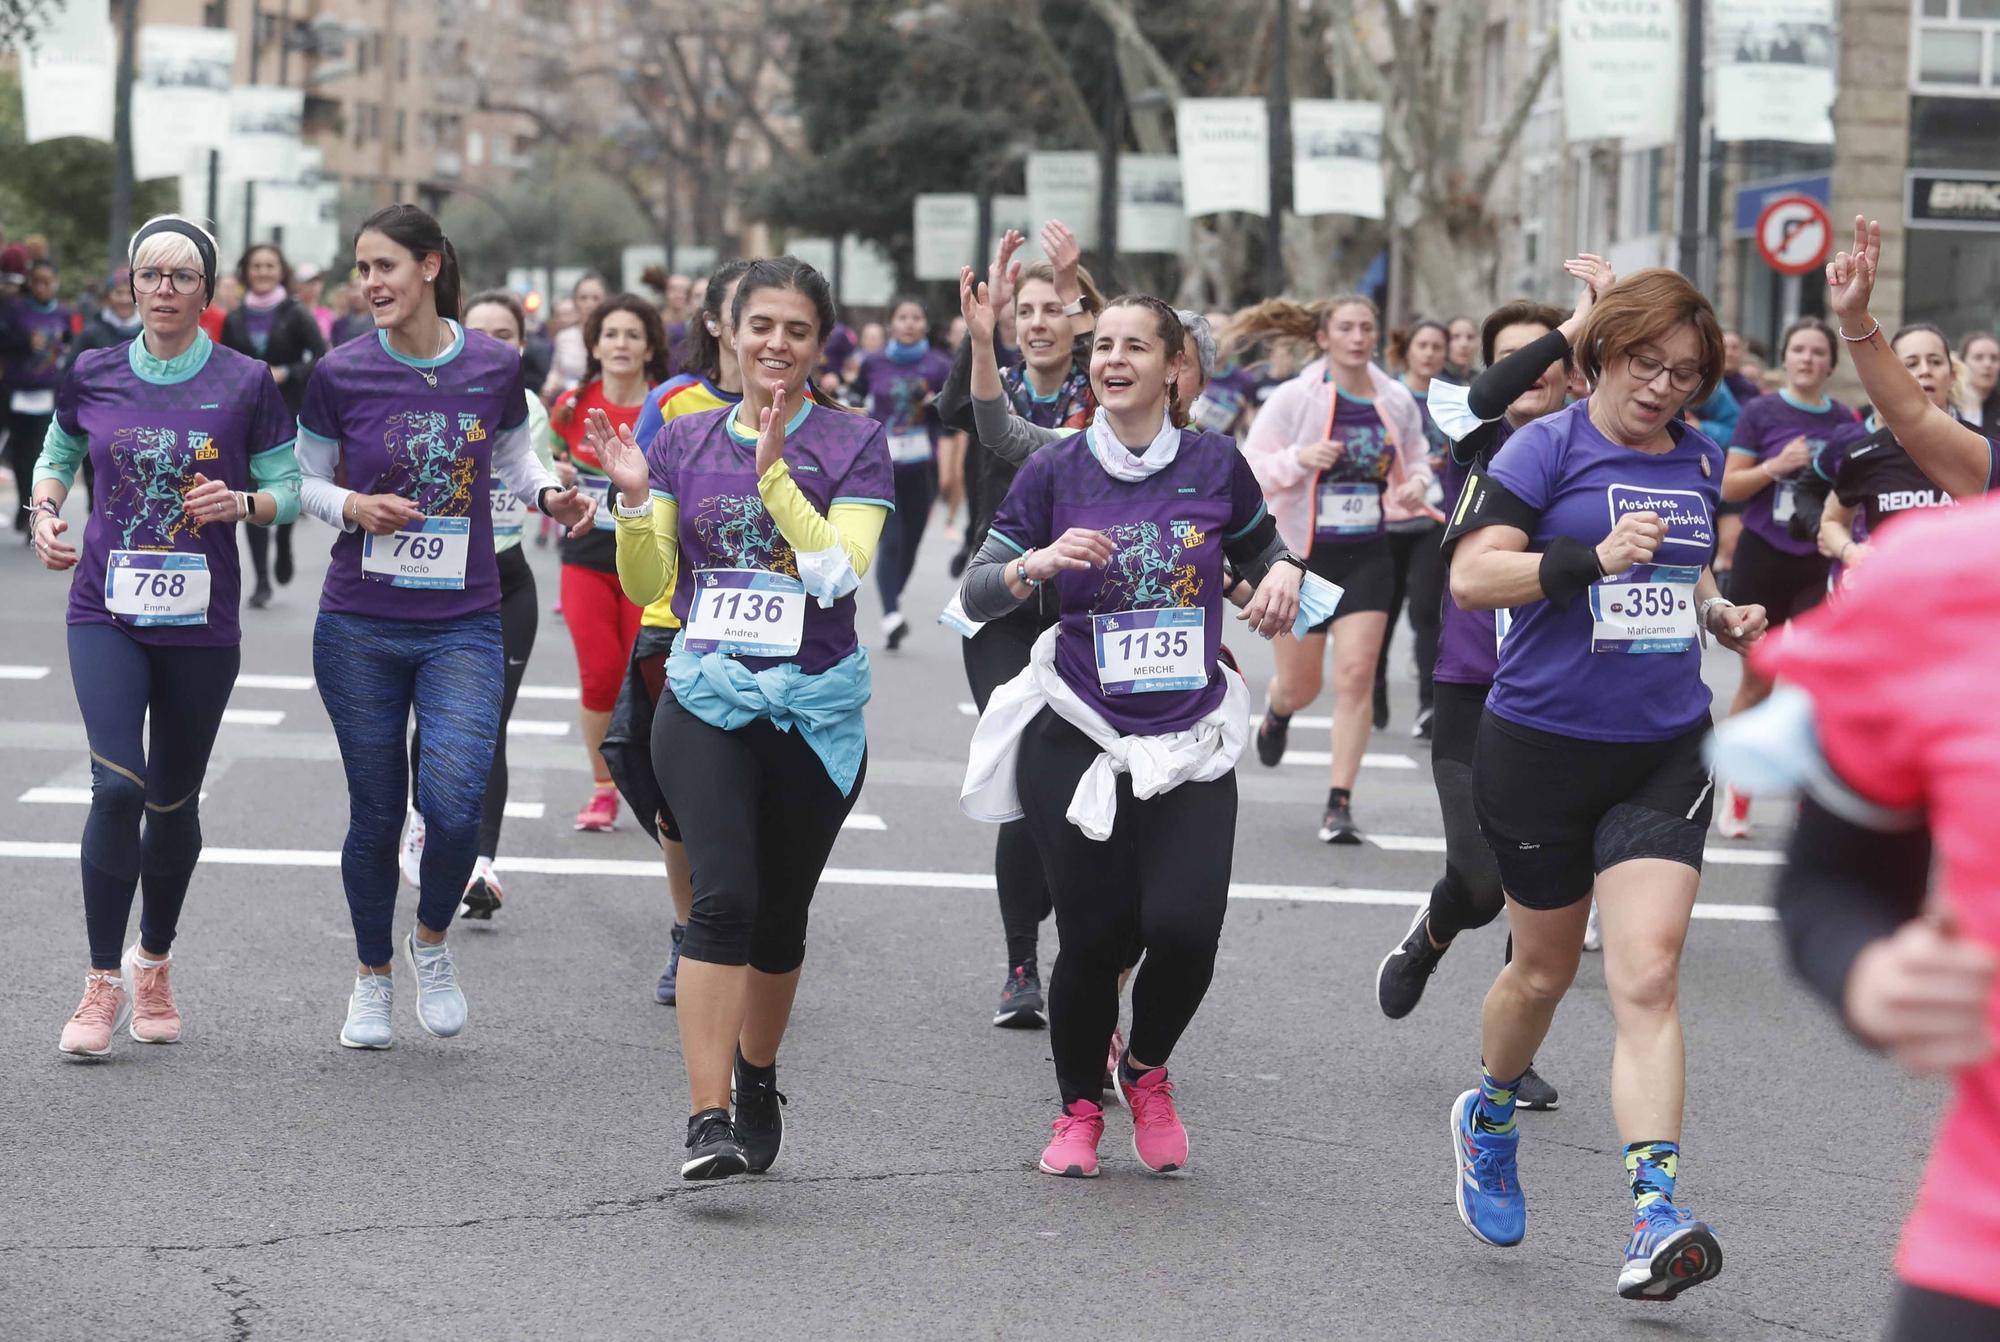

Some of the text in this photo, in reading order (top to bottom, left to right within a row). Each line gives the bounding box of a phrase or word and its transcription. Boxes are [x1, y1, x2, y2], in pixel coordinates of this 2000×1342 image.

[197, 450, 217, 459] FEM
[1342, 498, 1363, 514] 40
[1878, 490, 1960, 512] REDOLA
[393, 534, 444, 560] 769
[134, 572, 186, 597] 768
[143, 603, 171, 612] Emma
[712, 592, 785, 623] 1136
[1624, 587, 1674, 618] 359
[724, 627, 759, 639] Andrea
[1627, 626, 1676, 637] Maricarmen
[1118, 631, 1188, 661] 1135
[1133, 665, 1175, 676] MERCHE
